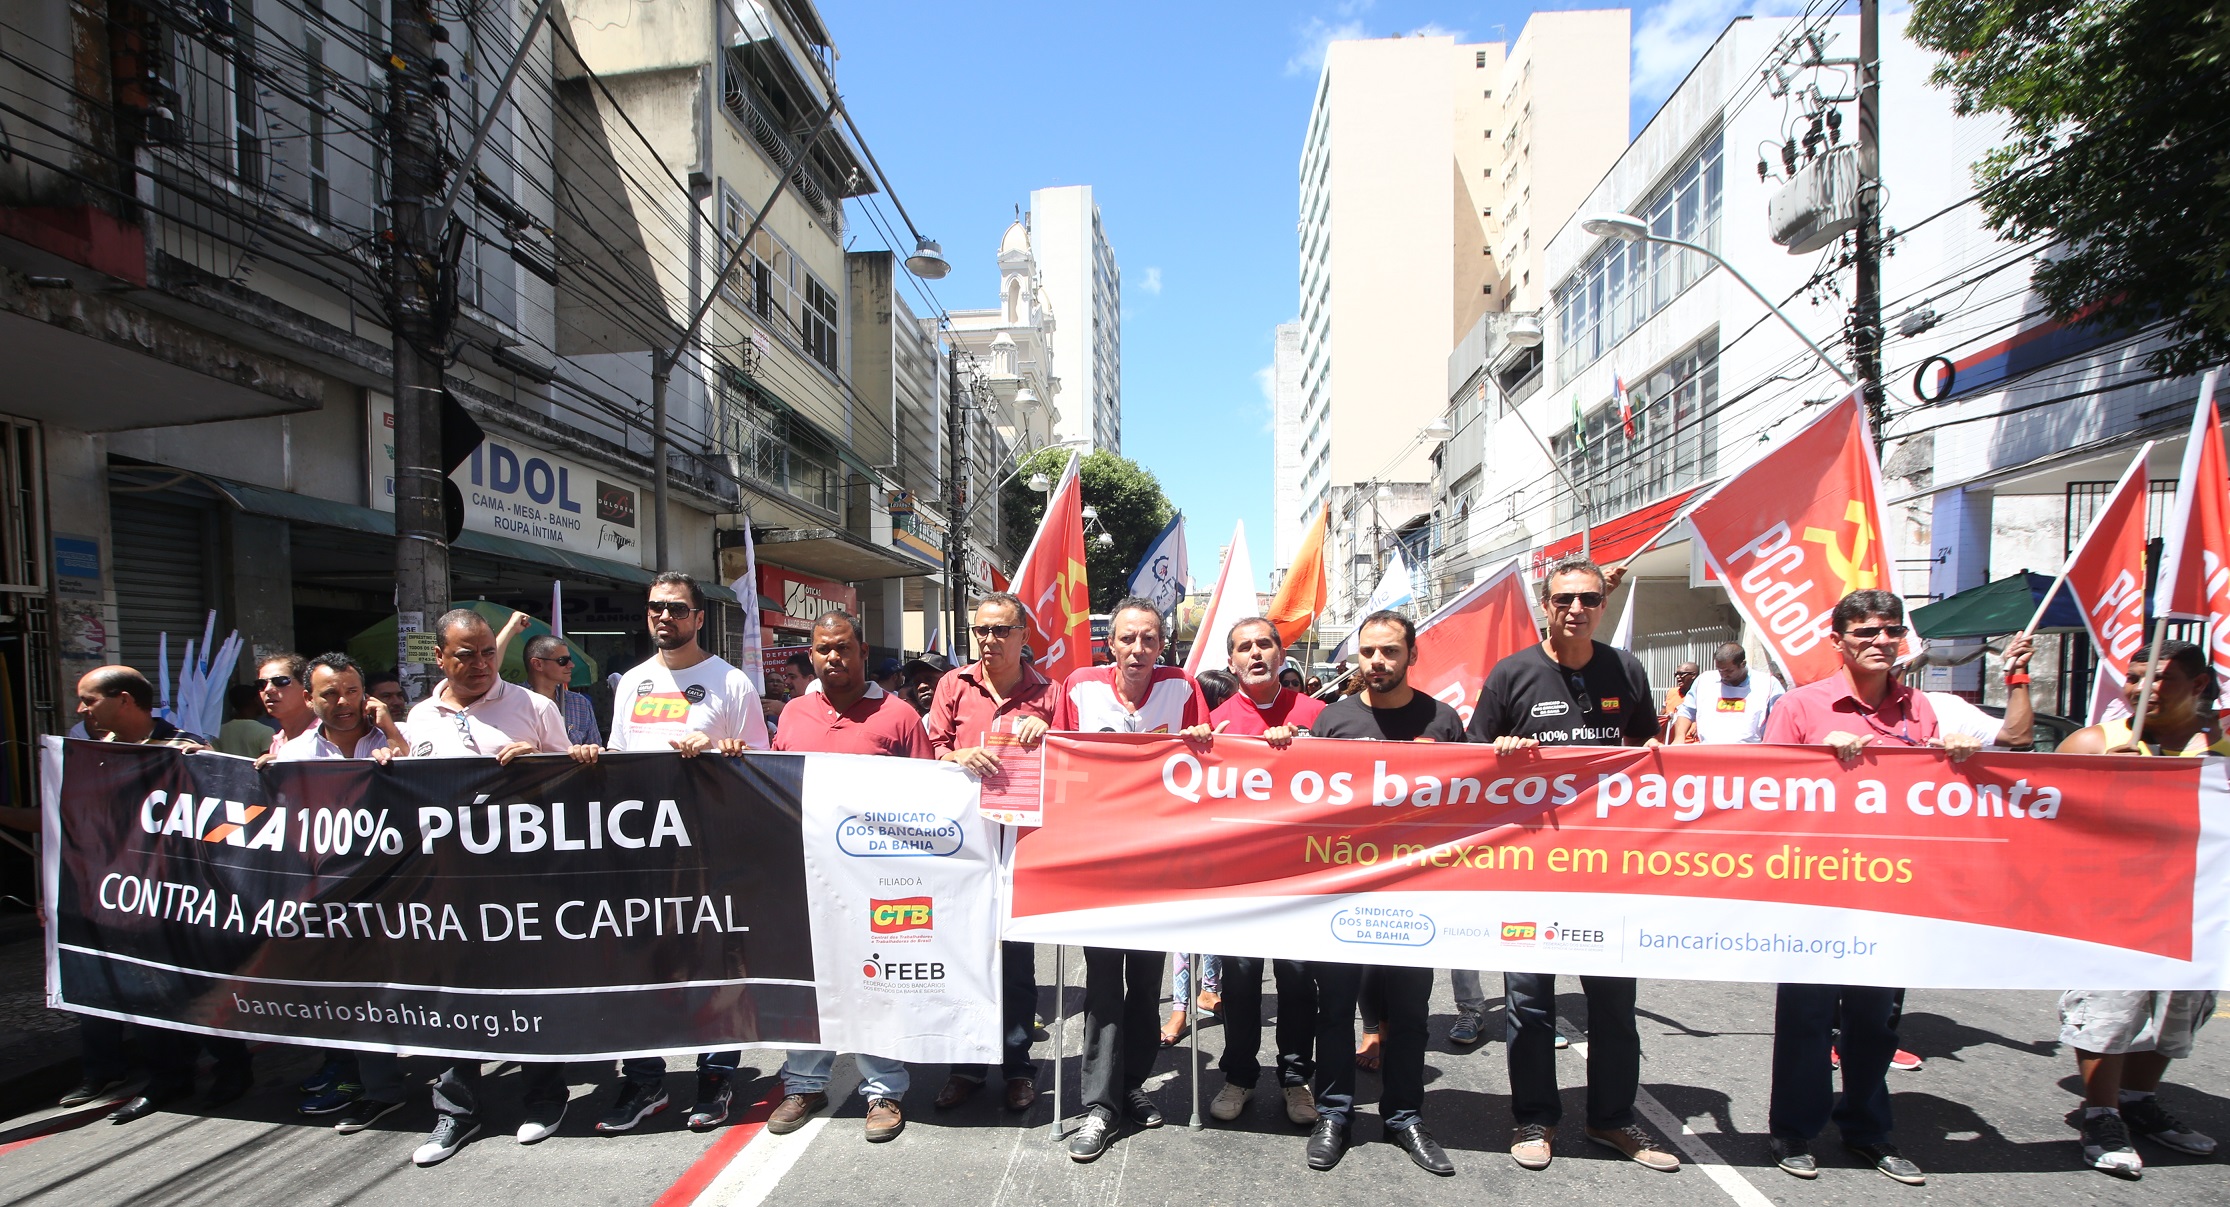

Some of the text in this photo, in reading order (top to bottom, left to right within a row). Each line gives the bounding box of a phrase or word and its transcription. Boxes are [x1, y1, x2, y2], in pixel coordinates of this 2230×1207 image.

[470, 443, 582, 514] IDOL
[472, 492, 505, 512] CAMA
[513, 507, 542, 522] MESA
[549, 513, 581, 531] BANHO
[494, 515, 564, 543] ROUPA ÍNTIMA
[805, 585, 821, 597] ÓTICAS
[1726, 520, 1836, 656] PCdoB
[634, 696, 690, 719] CTB
[1717, 699, 1746, 711] CTB
[1532, 725, 1620, 743] 100% PÚBLICA
[1162, 754, 2062, 821] Que os bancos paguem a conta
[141, 789, 692, 857] CAIXA 100% PÚBLICA
[865, 811, 936, 823] SINDICATO
[846, 824, 955, 838] DOS BANCÁRIOS
[869, 840, 934, 850] DA BAHIA
[1304, 835, 1913, 884] Não mexam em nossos direitos
[879, 876, 923, 886] FILIADO À
[99, 873, 750, 942] CONTRA A ABERTURA DE CAPITAL
[873, 904, 930, 926] CTB
[1355, 906, 1414, 918] SINDICATO
[1339, 918, 1429, 931] DOS BANCÁRIOS
[1443, 926, 1490, 938] FILIADO À
[1501, 924, 1536, 939] CTB
[1357, 930, 1410, 941] DA BAHIA
[1561, 929, 1604, 942] FEEB
[1639, 929, 1878, 960] bancariosbahia.org.br
[885, 962, 946, 981] FEEB
[233, 993, 543, 1037] bancariosbahia.org.br
